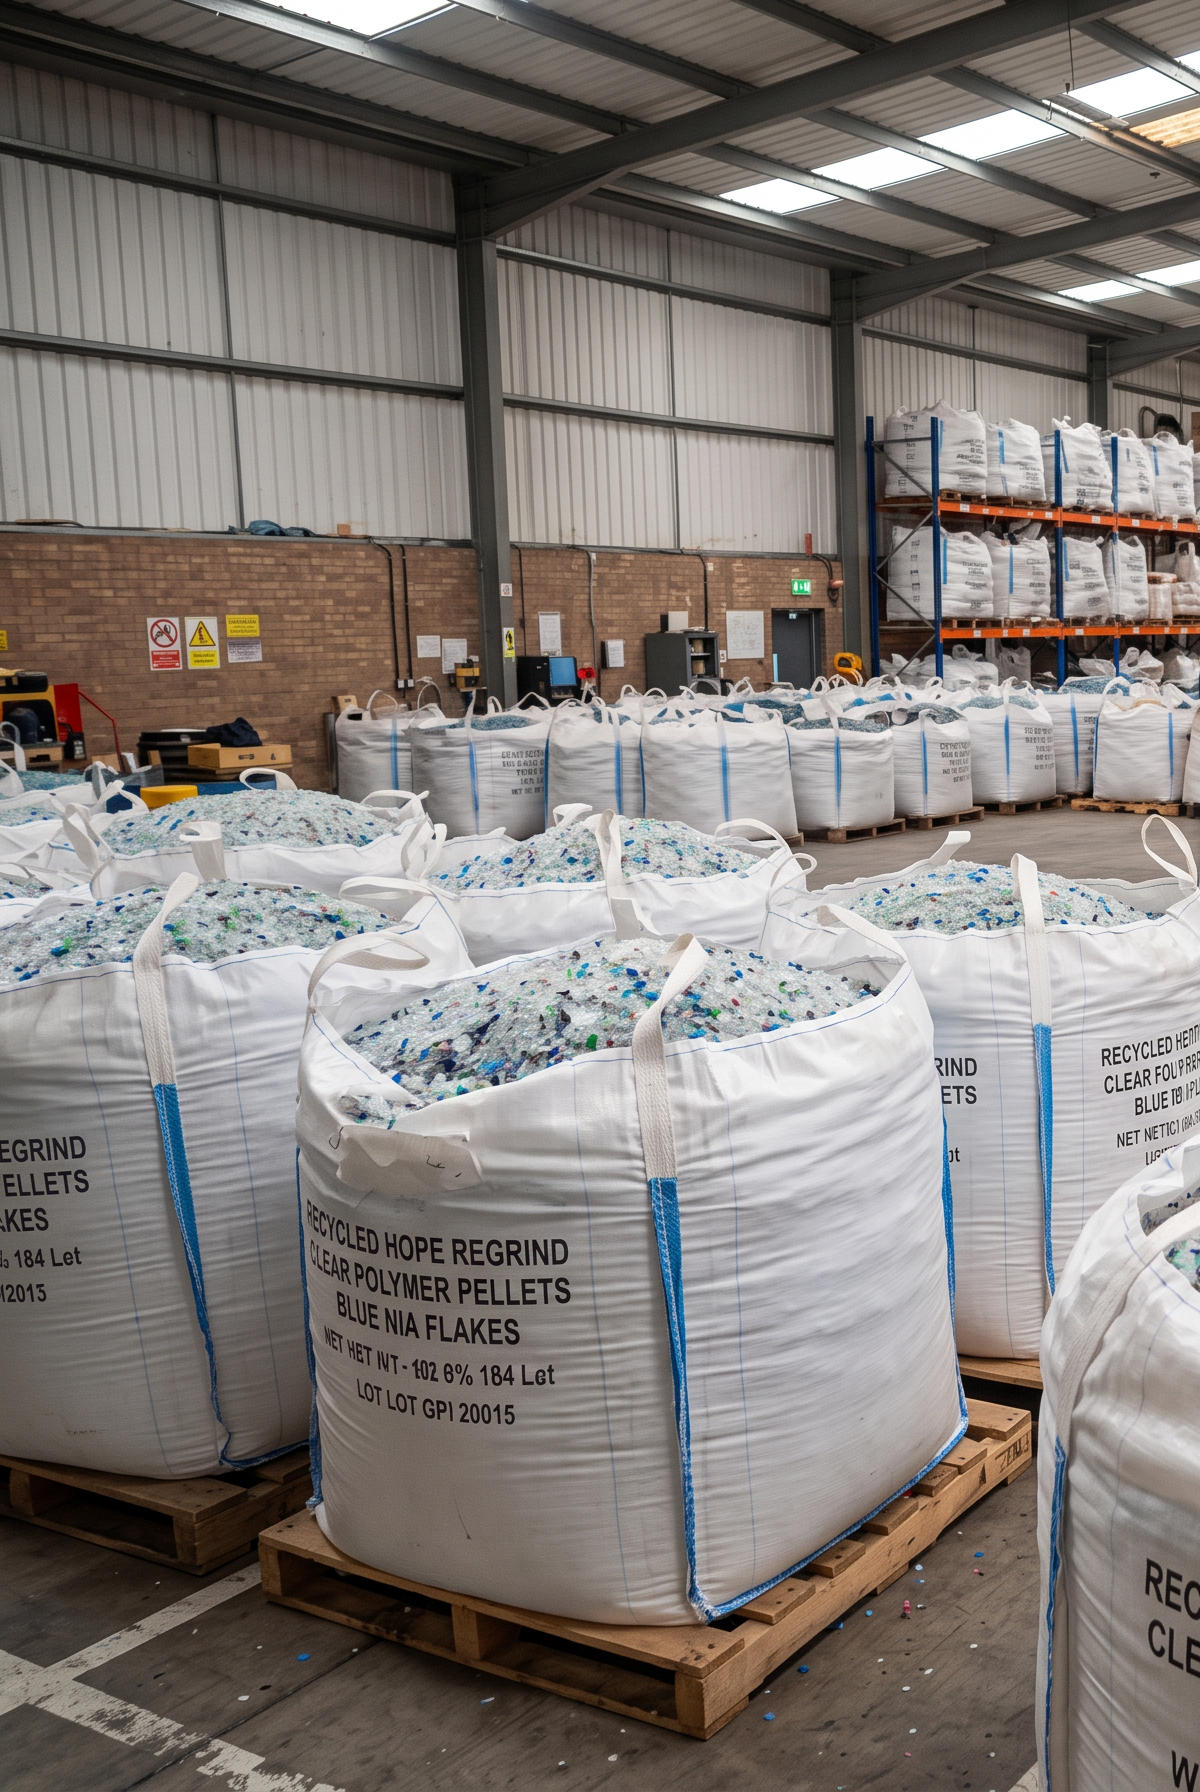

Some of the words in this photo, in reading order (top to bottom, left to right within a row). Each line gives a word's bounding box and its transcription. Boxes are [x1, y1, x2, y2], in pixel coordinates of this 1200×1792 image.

[1101, 1036, 1172, 1067] RECYCLED
[1104, 1068, 1152, 1094] CLEAR
[1134, 1090, 1168, 1116] BLUE
[1116, 1130, 1140, 1148] NET
[2, 1170, 90, 1196] ELLETS
[306, 1199, 379, 1255] RECYCLED
[384, 1233, 445, 1264] HOPE
[452, 1238, 570, 1267] REGRIND
[50, 1246, 82, 1266] Let
[310, 1240, 350, 1284] CLEAR
[354, 1264, 450, 1304] POLYMER
[458, 1277, 572, 1305] PELLETS
[336, 1290, 380, 1330] BLUE
[385, 1310, 420, 1339] NIA
[426, 1314, 520, 1346] FLAKES
[324, 1326, 343, 1354] NET
[521, 1364, 556, 1386] Let
[356, 1378, 382, 1406] LOT
[386, 1390, 418, 1416] LOT
[460, 1402, 516, 1426] 20015
